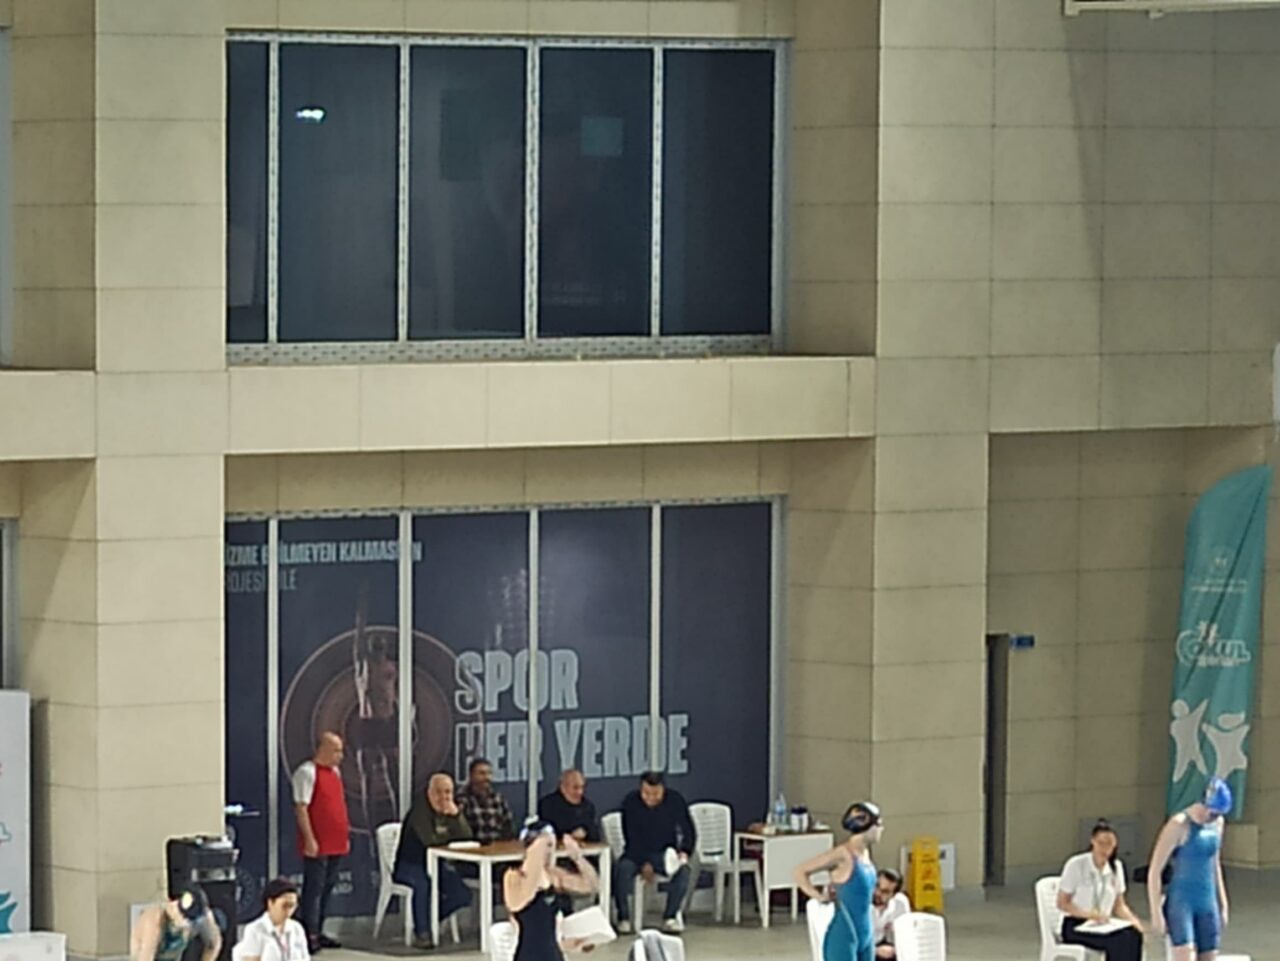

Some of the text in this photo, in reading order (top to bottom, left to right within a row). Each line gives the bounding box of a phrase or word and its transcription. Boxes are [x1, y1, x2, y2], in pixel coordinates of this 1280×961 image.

[455, 649, 579, 714] SPOR
[455, 721, 543, 785] HER
[554, 713, 689, 778] YERDE
